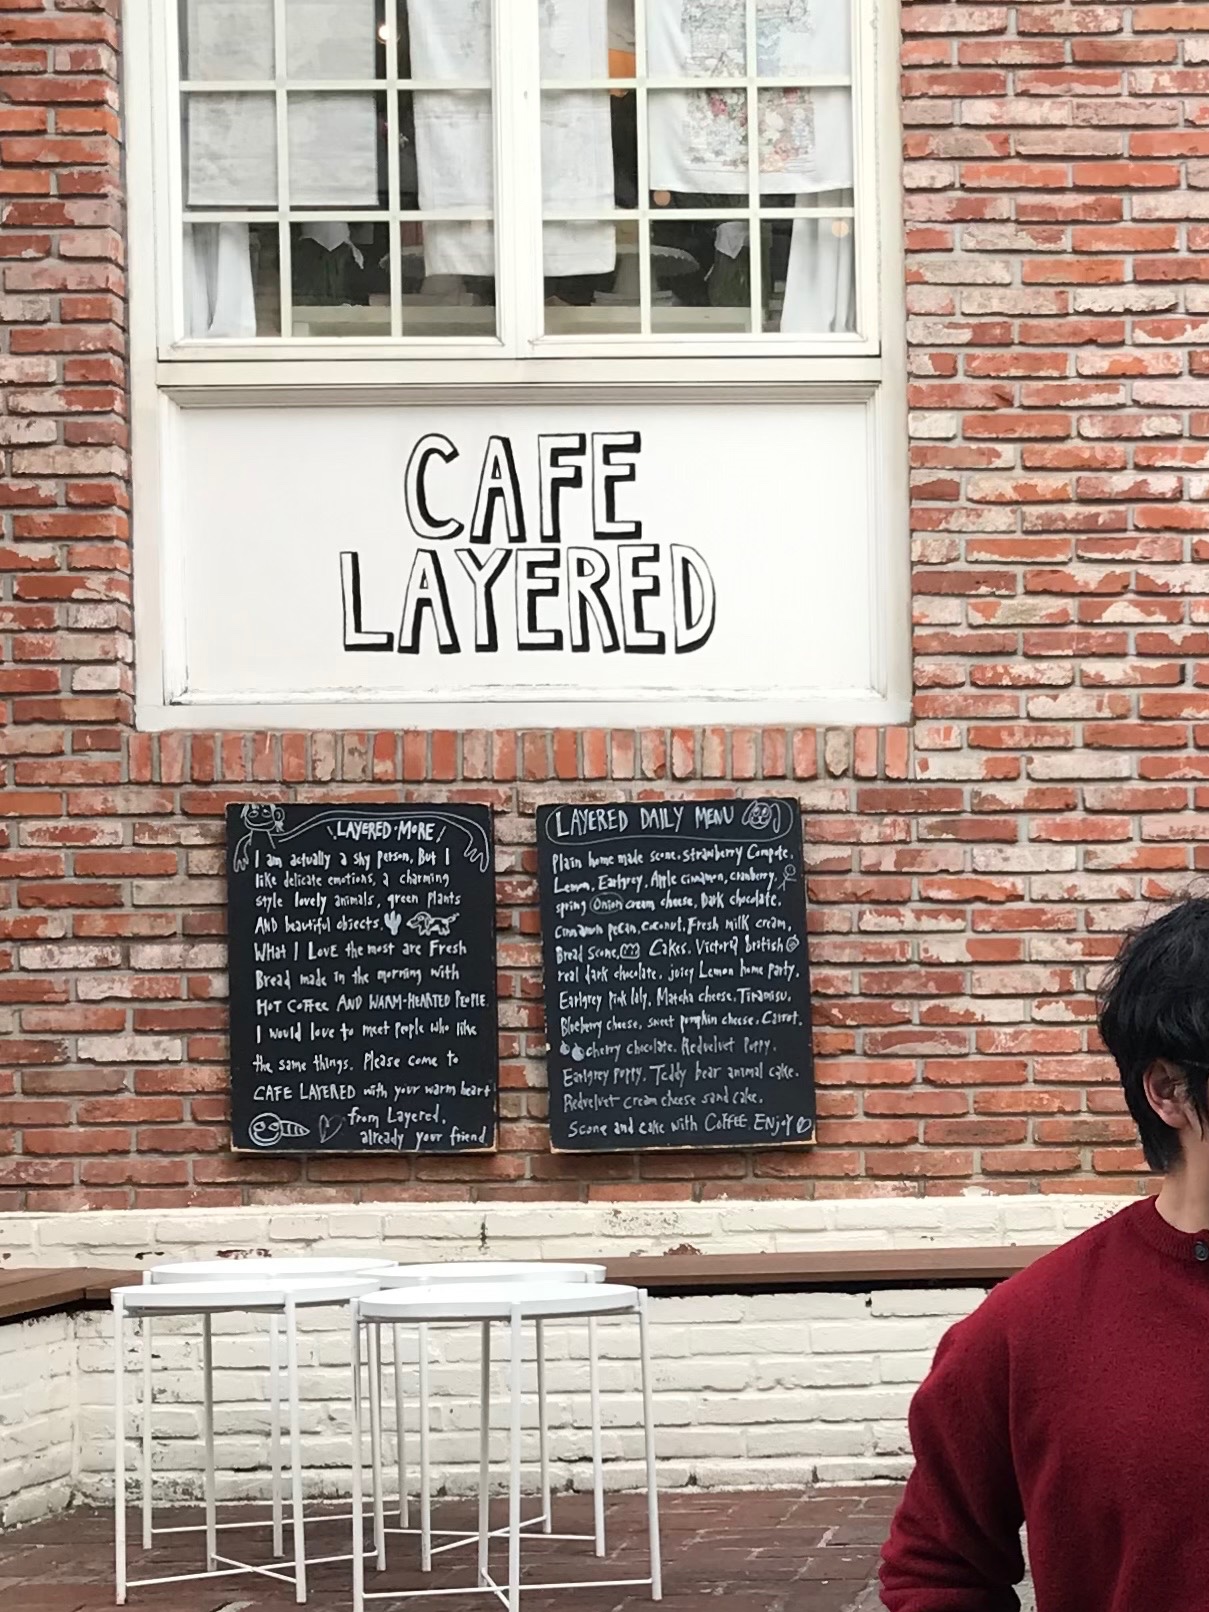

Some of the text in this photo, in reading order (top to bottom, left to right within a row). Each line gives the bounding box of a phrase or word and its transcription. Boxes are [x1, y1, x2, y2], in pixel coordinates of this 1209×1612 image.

[404, 431, 642, 543] CAFE
[339, 543, 716, 655] LAYERED
[337, 821, 392, 841] LAYERED
[555, 806, 734, 837] LAYERED DAILY MENU
[255, 850, 259, 868] I
[266, 854, 283, 868] am
[290, 850, 331, 870] actually
[339, 852, 347, 866] a
[353, 851, 371, 871] shy
[418, 847, 437, 866] But
[445, 847, 450, 866] I
[552, 853, 583, 875] Plain
[588, 851, 614, 868] home
[617, 849, 644, 866] made
[284, 870, 322, 888] delicate
[328, 872, 376, 886] emotions,
[383, 872, 389, 887] a
[399, 869, 450, 888] charming
[256, 892, 283, 913] style
[295, 891, 327, 915] lovely
[334, 891, 381, 909] animals,
[387, 894, 419, 908] green
[556, 900, 587, 919] spring
[593, 896, 623, 911] Onion
[625, 900, 656, 911] cream
[285, 915, 331, 935] beautiful
[687, 916, 719, 935] Fresh
[294, 941, 299, 961] I
[345, 940, 364, 959] the
[367, 942, 395, 955] most
[402, 943, 421, 956] are
[429, 939, 467, 957] Fresh
[555, 944, 583, 965] Bread
[255, 970, 291, 990] Bread
[300, 968, 327, 987] made
[351, 966, 369, 985] the
[377, 968, 422, 986] morning
[430, 963, 460, 980] with
[558, 966, 579, 983] real
[585, 964, 609, 985] dark
[699, 960, 734, 978] Lemon
[740, 958, 764, 977] home
[559, 991, 602, 1012] Earlgrey
[657, 987, 694, 1006] Matcha
[257, 1025, 261, 1044] I
[269, 1022, 302, 1042] would
[311, 1022, 335, 1041] love
[340, 1023, 354, 1042] to
[362, 1020, 390, 1038] meet
[430, 1017, 450, 1034] who
[252, 1054, 273, 1074] the
[278, 1059, 307, 1072] same
[364, 1050, 401, 1071] Please
[408, 1055, 438, 1067] come
[447, 1050, 459, 1067] to
[586, 1041, 621, 1062] cherry
[562, 1068, 609, 1087] Earlgrey
[695, 1060, 722, 1081] bear
[727, 1062, 763, 1079] animal
[253, 1080, 491, 1102] CAFE LAYERED with your warm heart
[623, 1095, 658, 1109] cream
[661, 1090, 696, 1107] cheese
[347, 1106, 379, 1129] from
[568, 1115, 698, 1138] Scone and cake with
[360, 1128, 404, 1149] already
[414, 1132, 443, 1153] your
